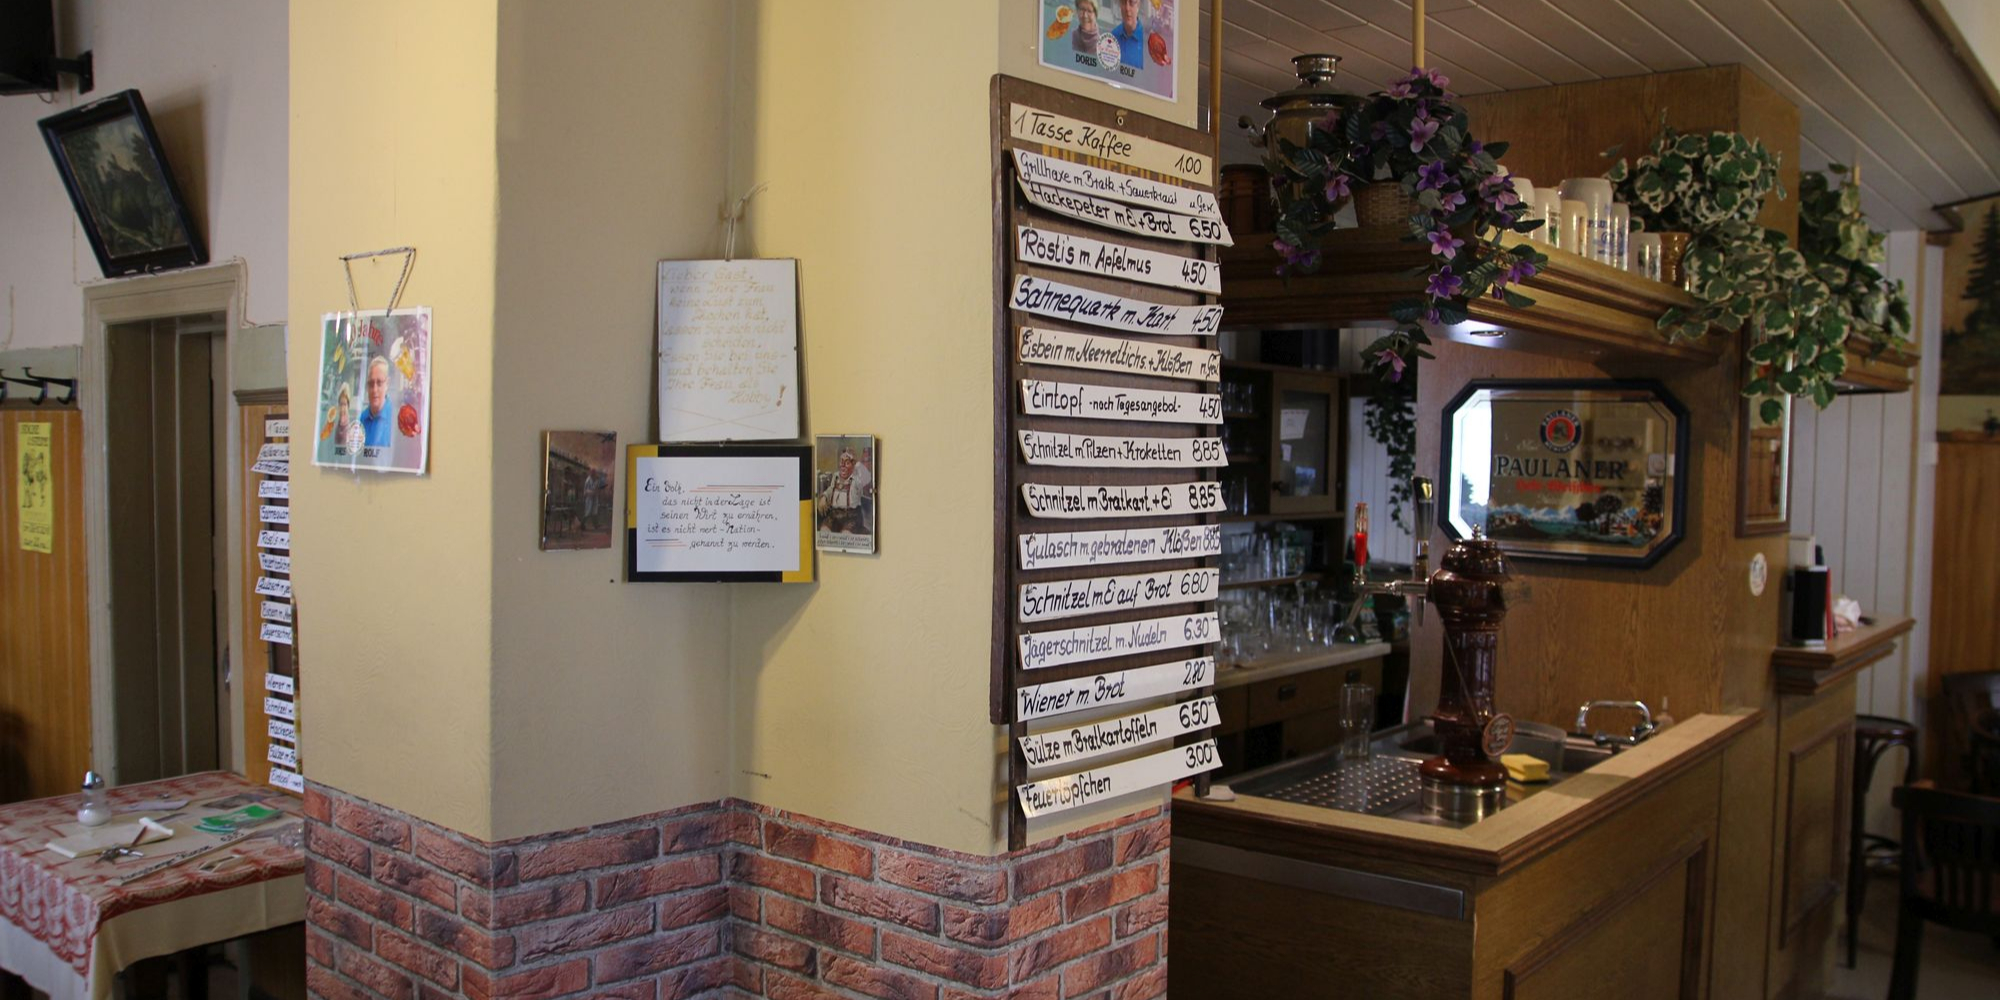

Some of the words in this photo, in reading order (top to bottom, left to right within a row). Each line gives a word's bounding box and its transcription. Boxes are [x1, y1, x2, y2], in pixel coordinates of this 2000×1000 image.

[1075, 53, 1097, 67] DORIS
[1120, 66, 1135, 77] ROLF
[1015, 110, 1027, 134] 1
[1031, 112, 1073, 143] Tasse
[1078, 126, 1132, 157] Kaffee
[1020, 151, 1072, 184] Grillhaxe
[1028, 182, 1110, 220] Hackepeter
[1079, 249, 1091, 266] m.
[1094, 244, 1152, 275] Apfelmus
[1015, 277, 1121, 323] Sahnequark
[1120, 309, 1136, 326] m.
[1020, 328, 1063, 360] Eisbein
[1031, 380, 1084, 416] Eintopf
[1024, 433, 1073, 460] Schnitzel
[1494, 455, 1626, 481] PAULANER
[644, 477, 660, 493] Ein
[1029, 484, 1084, 513] Schnitzel
[660, 510, 689, 520] seinen
[661, 496, 678, 506] das
[681, 495, 703, 507] nicht
[759, 496, 772, 506] ist
[647, 523, 659, 533] ist
[674, 523, 696, 534] nicht
[1025, 534, 1078, 567] Gulasch
[1160, 527, 1202, 556] Klößen
[1023, 581, 1091, 617] Schnitzel
[1116, 580, 1142, 609] auf
[1144, 574, 1173, 600] Brot
[1024, 625, 1113, 668] Jägerschnitzel
[1022, 684, 1074, 716] Wiener
[1076, 688, 1090, 705] m.
[1094, 672, 1125, 702] Brot
[1024, 734, 1061, 765] Sülze
[1023, 771, 1111, 811] Feuertöpfchen
